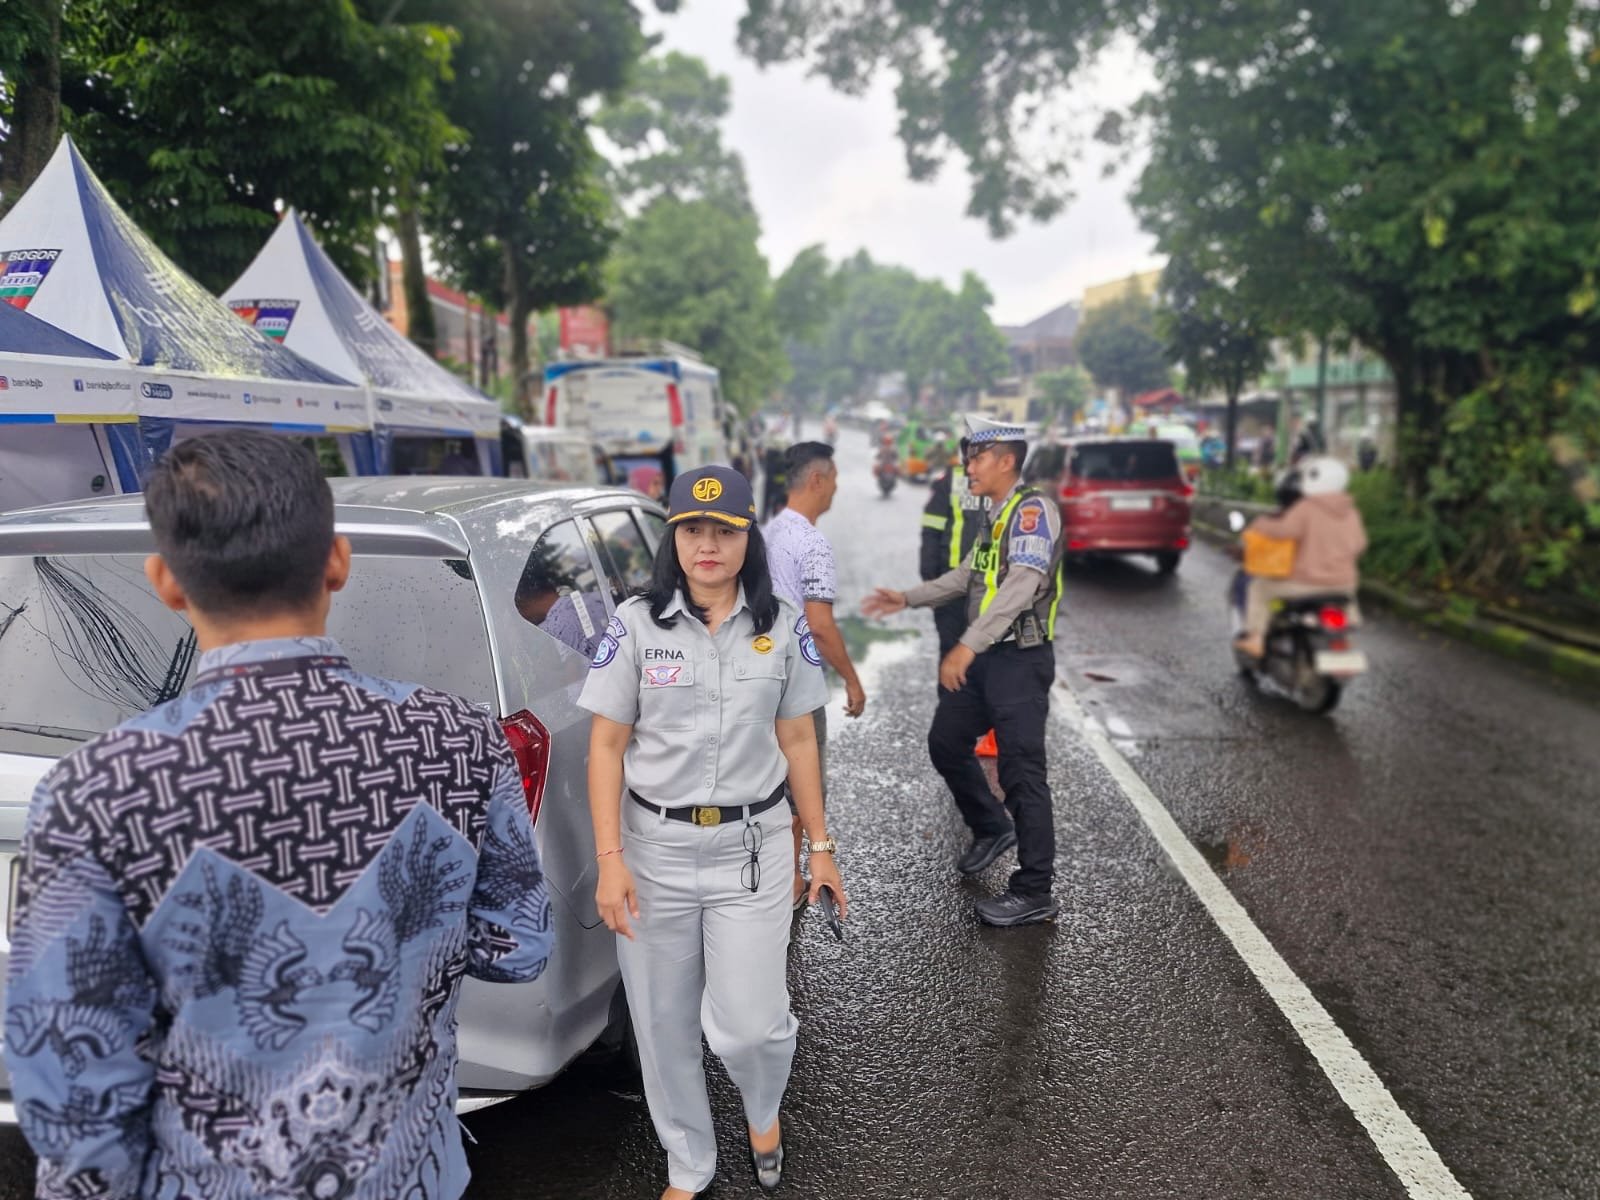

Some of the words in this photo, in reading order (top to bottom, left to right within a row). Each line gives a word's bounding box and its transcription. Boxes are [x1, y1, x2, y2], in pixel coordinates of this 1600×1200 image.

[8, 250, 58, 261] BOGOR
[12, 377, 43, 389] bankbjb
[645, 648, 685, 660] ERNA
